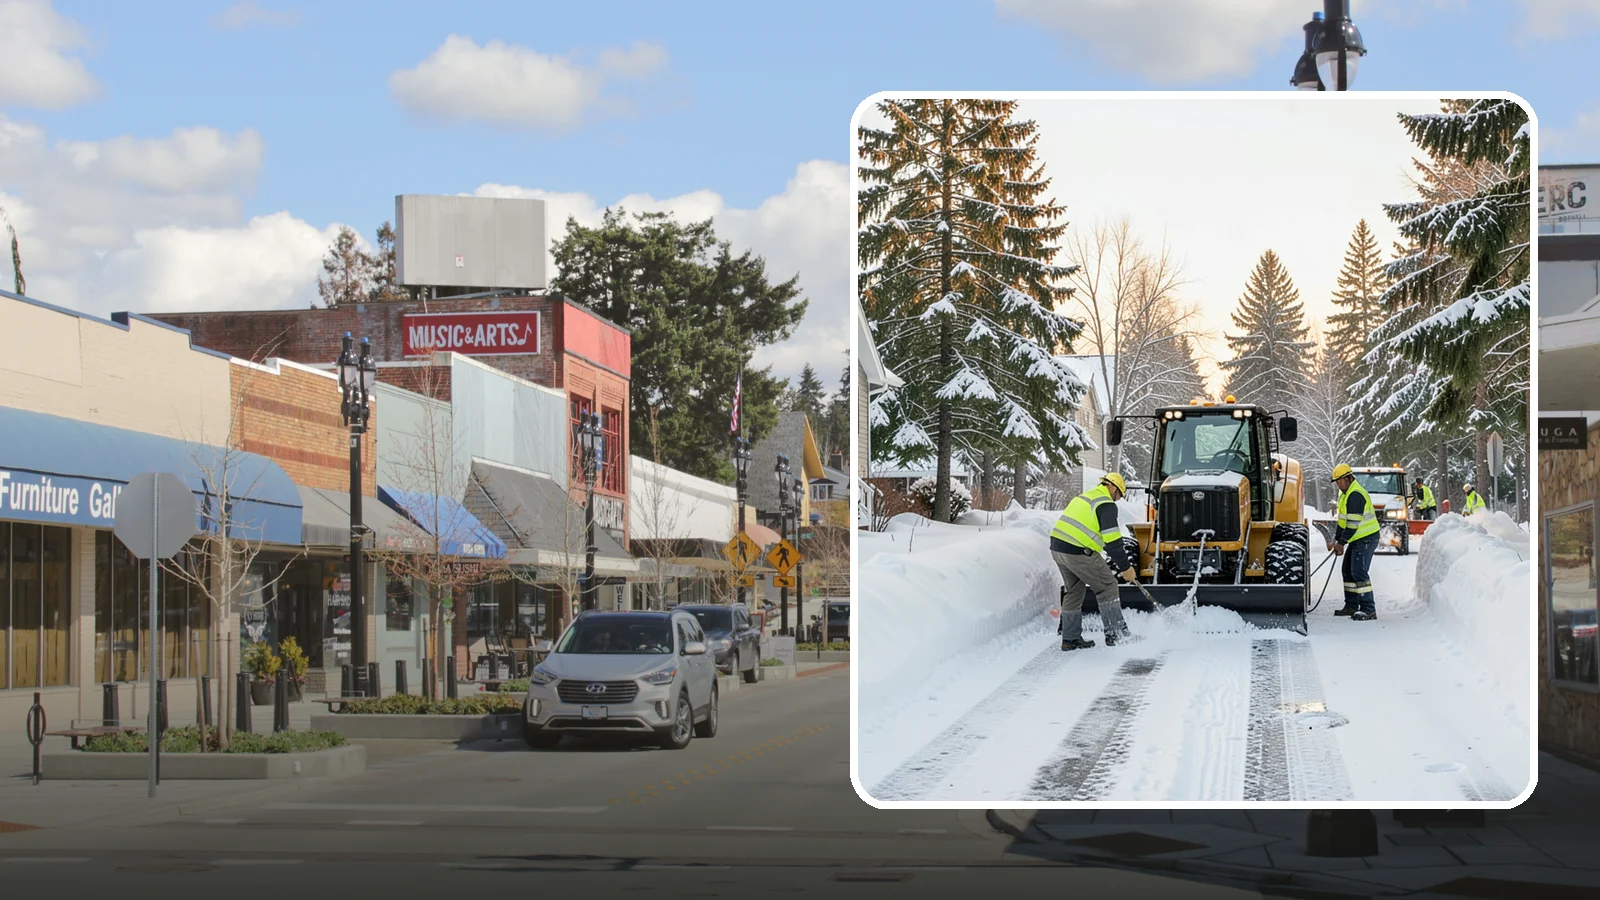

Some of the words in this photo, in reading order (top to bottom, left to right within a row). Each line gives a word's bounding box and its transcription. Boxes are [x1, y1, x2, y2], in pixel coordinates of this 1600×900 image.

[1538, 181, 1587, 212] ERC
[409, 323, 520, 349] MUSIC&ARTS
[1540, 427, 1577, 436] UGA
[0, 471, 79, 515] Furniture
[89, 482, 122, 519] Gal
[454, 563, 479, 574] SUSHI
